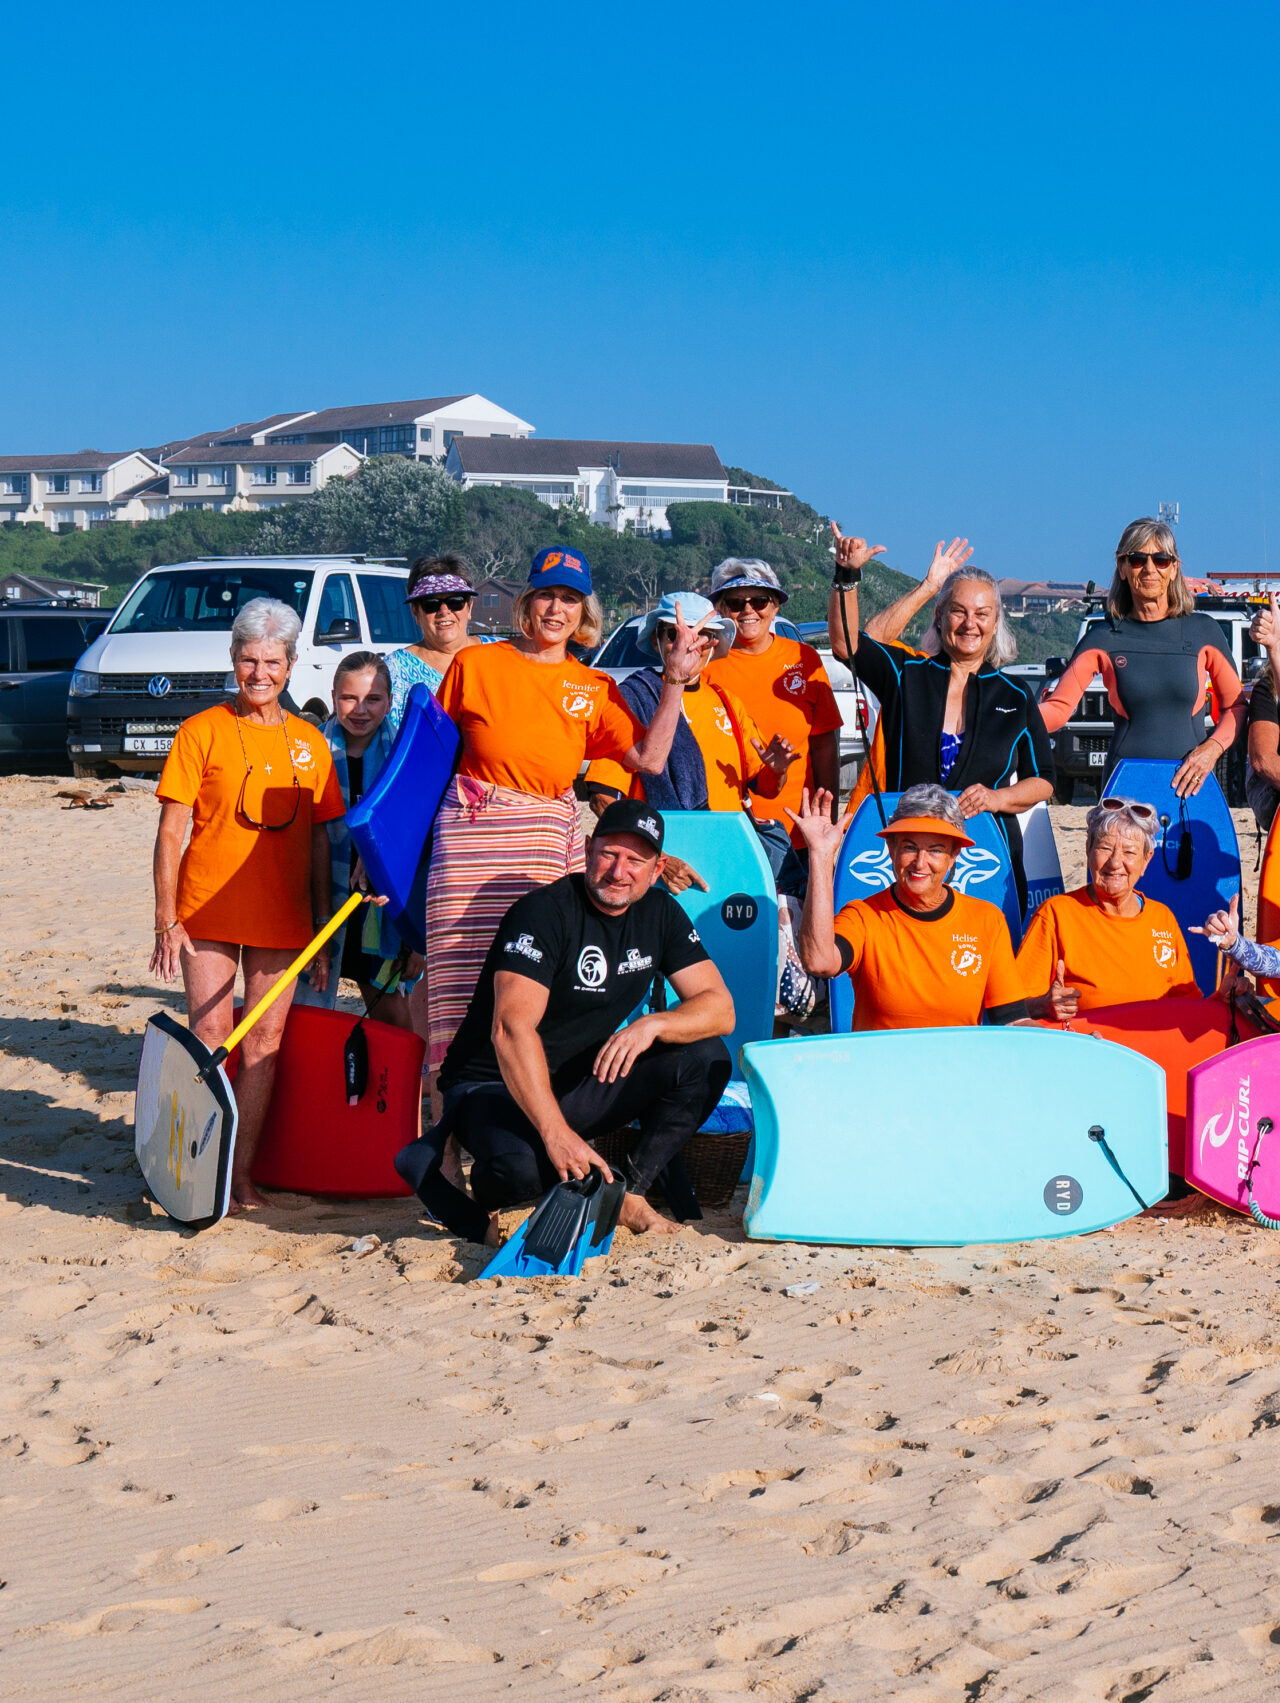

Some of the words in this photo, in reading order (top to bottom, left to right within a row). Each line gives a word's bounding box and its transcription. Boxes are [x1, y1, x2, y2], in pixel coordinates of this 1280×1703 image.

[562, 680, 600, 692] Jennifer
[134, 740, 146, 750] CX
[726, 905, 753, 919] RYD
[952, 934, 979, 942] Helise
[1238, 1074, 1250, 1137] CURL
[1237, 1138, 1249, 1180] RIP
[1056, 1180, 1071, 1211] RYD
